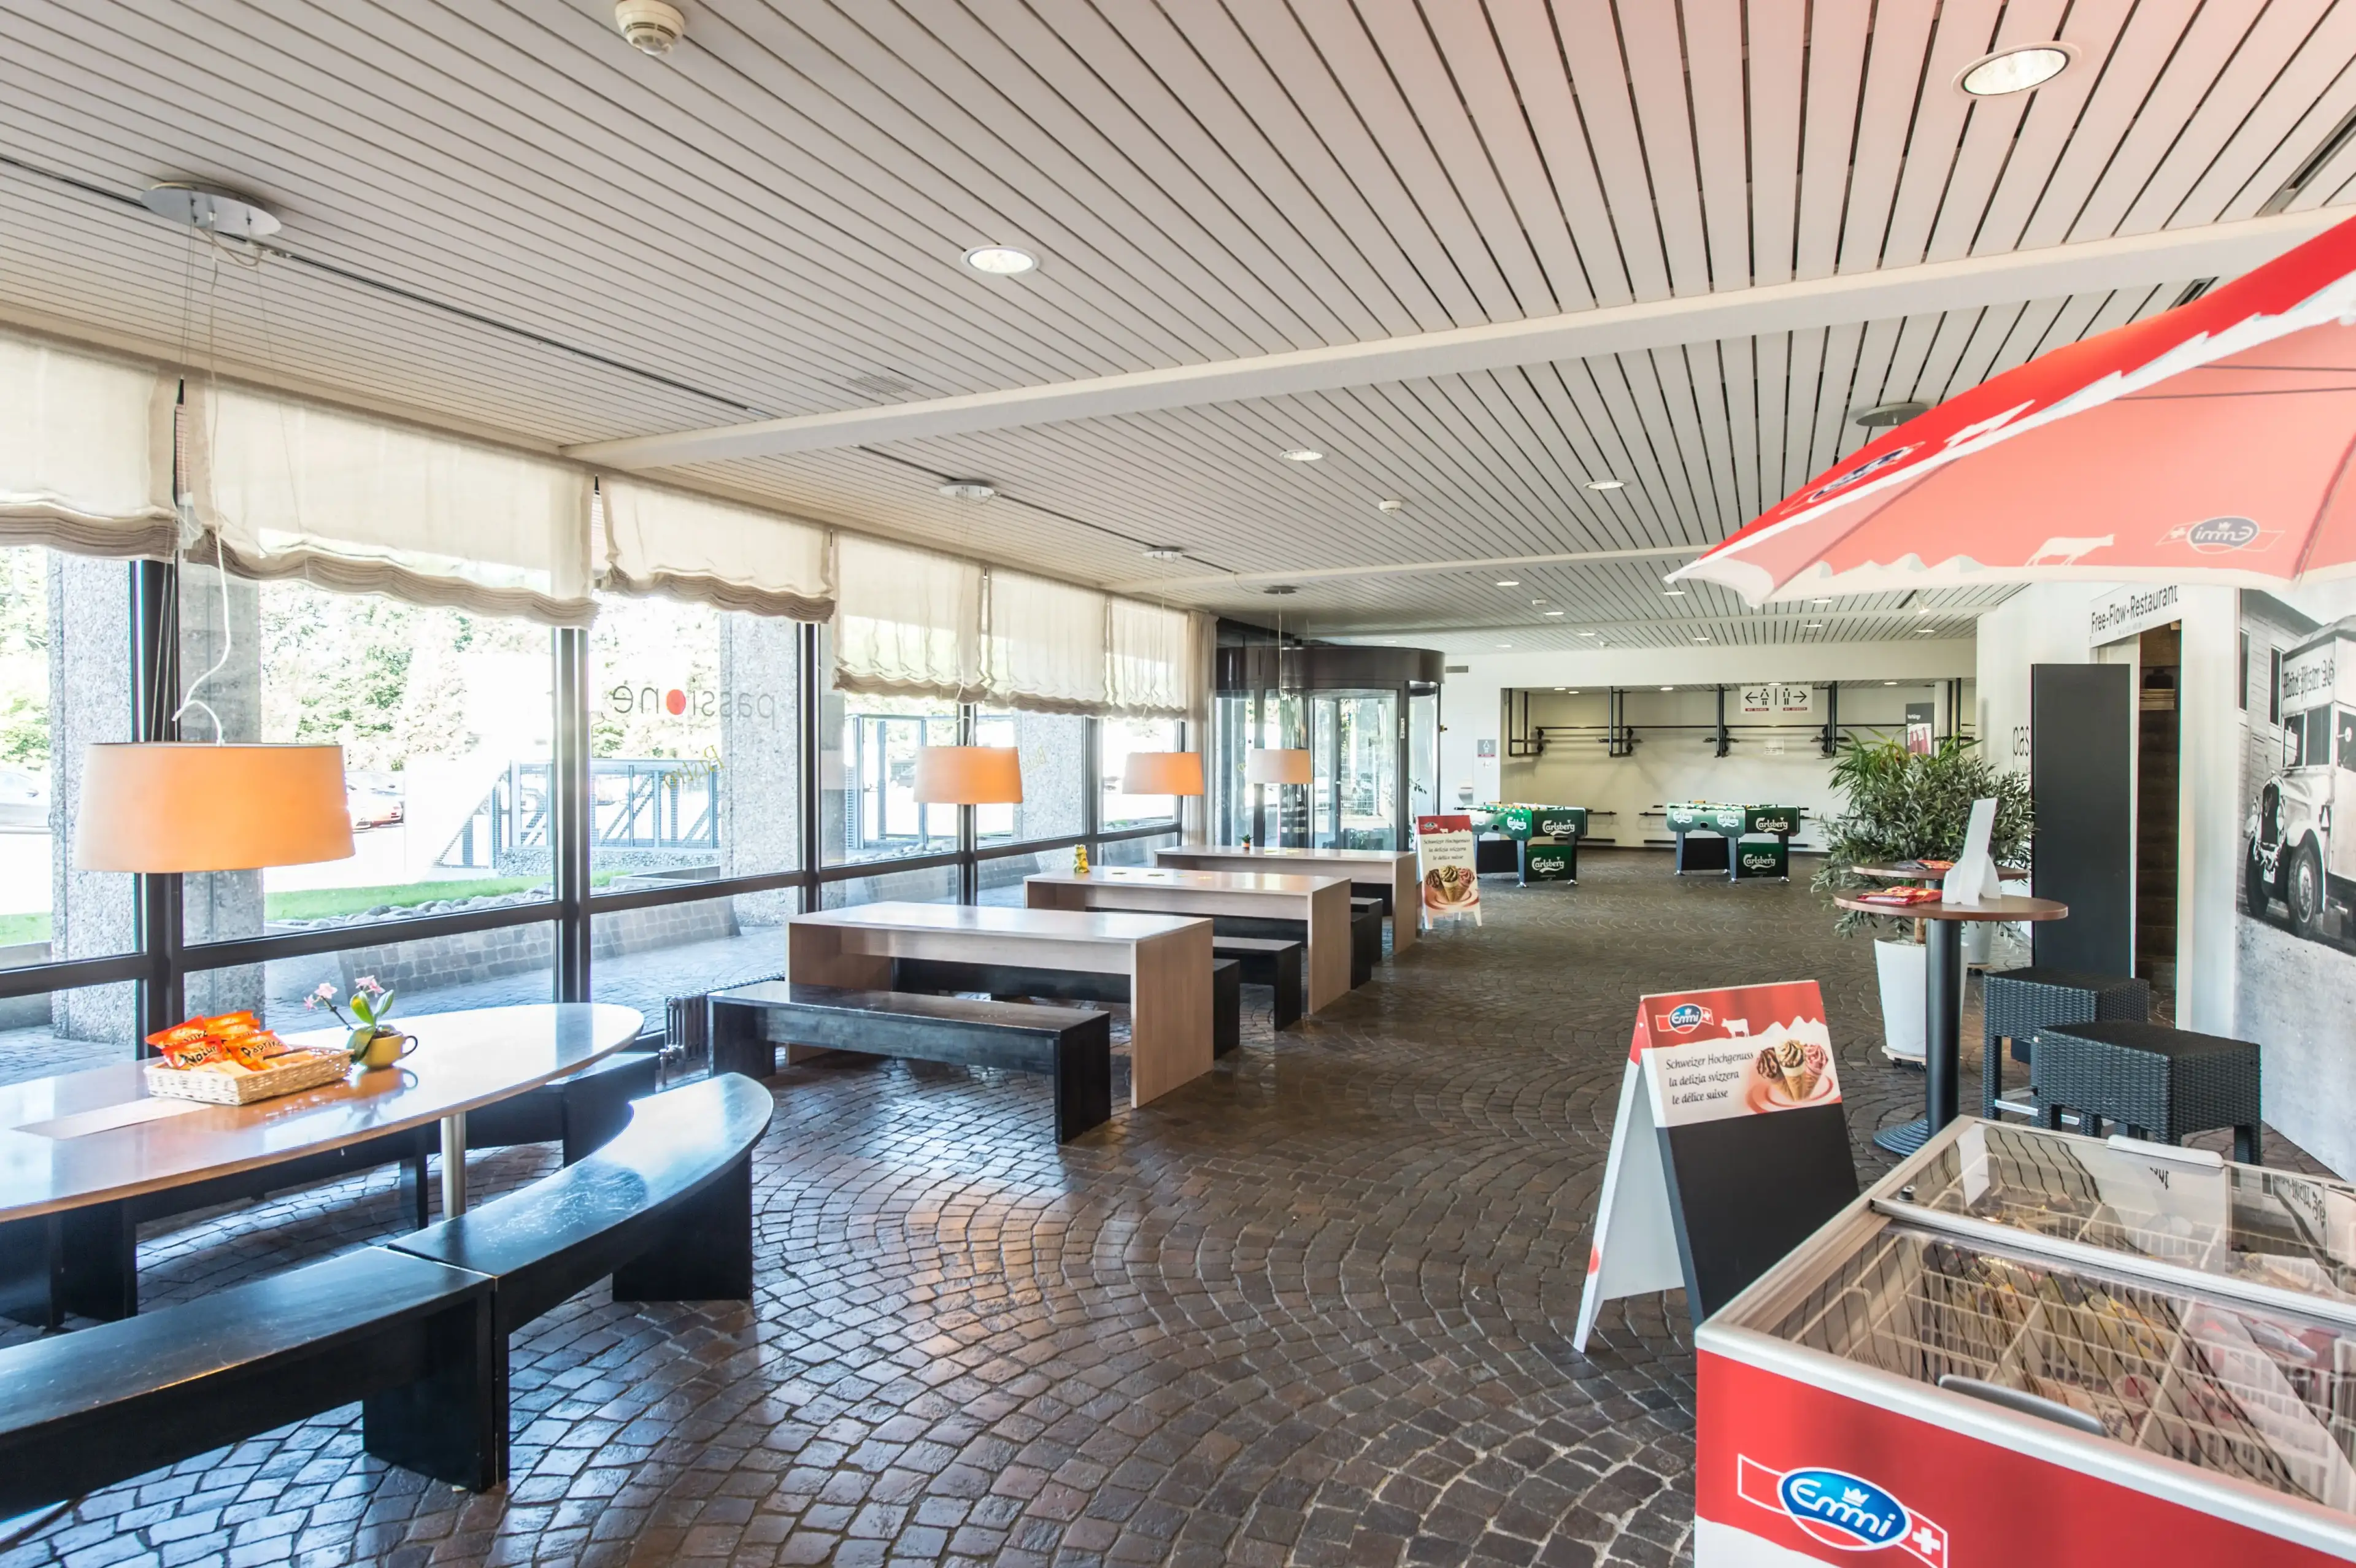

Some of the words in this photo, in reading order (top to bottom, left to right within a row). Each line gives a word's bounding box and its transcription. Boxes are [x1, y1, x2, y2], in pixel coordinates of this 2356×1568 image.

[2091, 585, 2178, 634] Free-Flow-Restaurant
[1542, 820, 1575, 836] Carlsberg
[1755, 817, 1788, 832] Carlsberg
[1531, 857, 1565, 873] Carlsberg
[1743, 854, 1776, 869] Carlsberg
[1671, 1010, 1700, 1024] Emmi
[1666, 1057, 1706, 1070] Schweizer
[1707, 1050, 1754, 1066] Hochgenuss
[1669, 1076, 1678, 1088] la
[1680, 1072, 1706, 1087] delizia
[1707, 1070, 1739, 1084] svizzera
[1672, 1094, 1680, 1105] le
[1681, 1091, 1705, 1105] délice
[1706, 1089, 1728, 1102] suisse
[1789, 1477, 1897, 1538] Emmi
